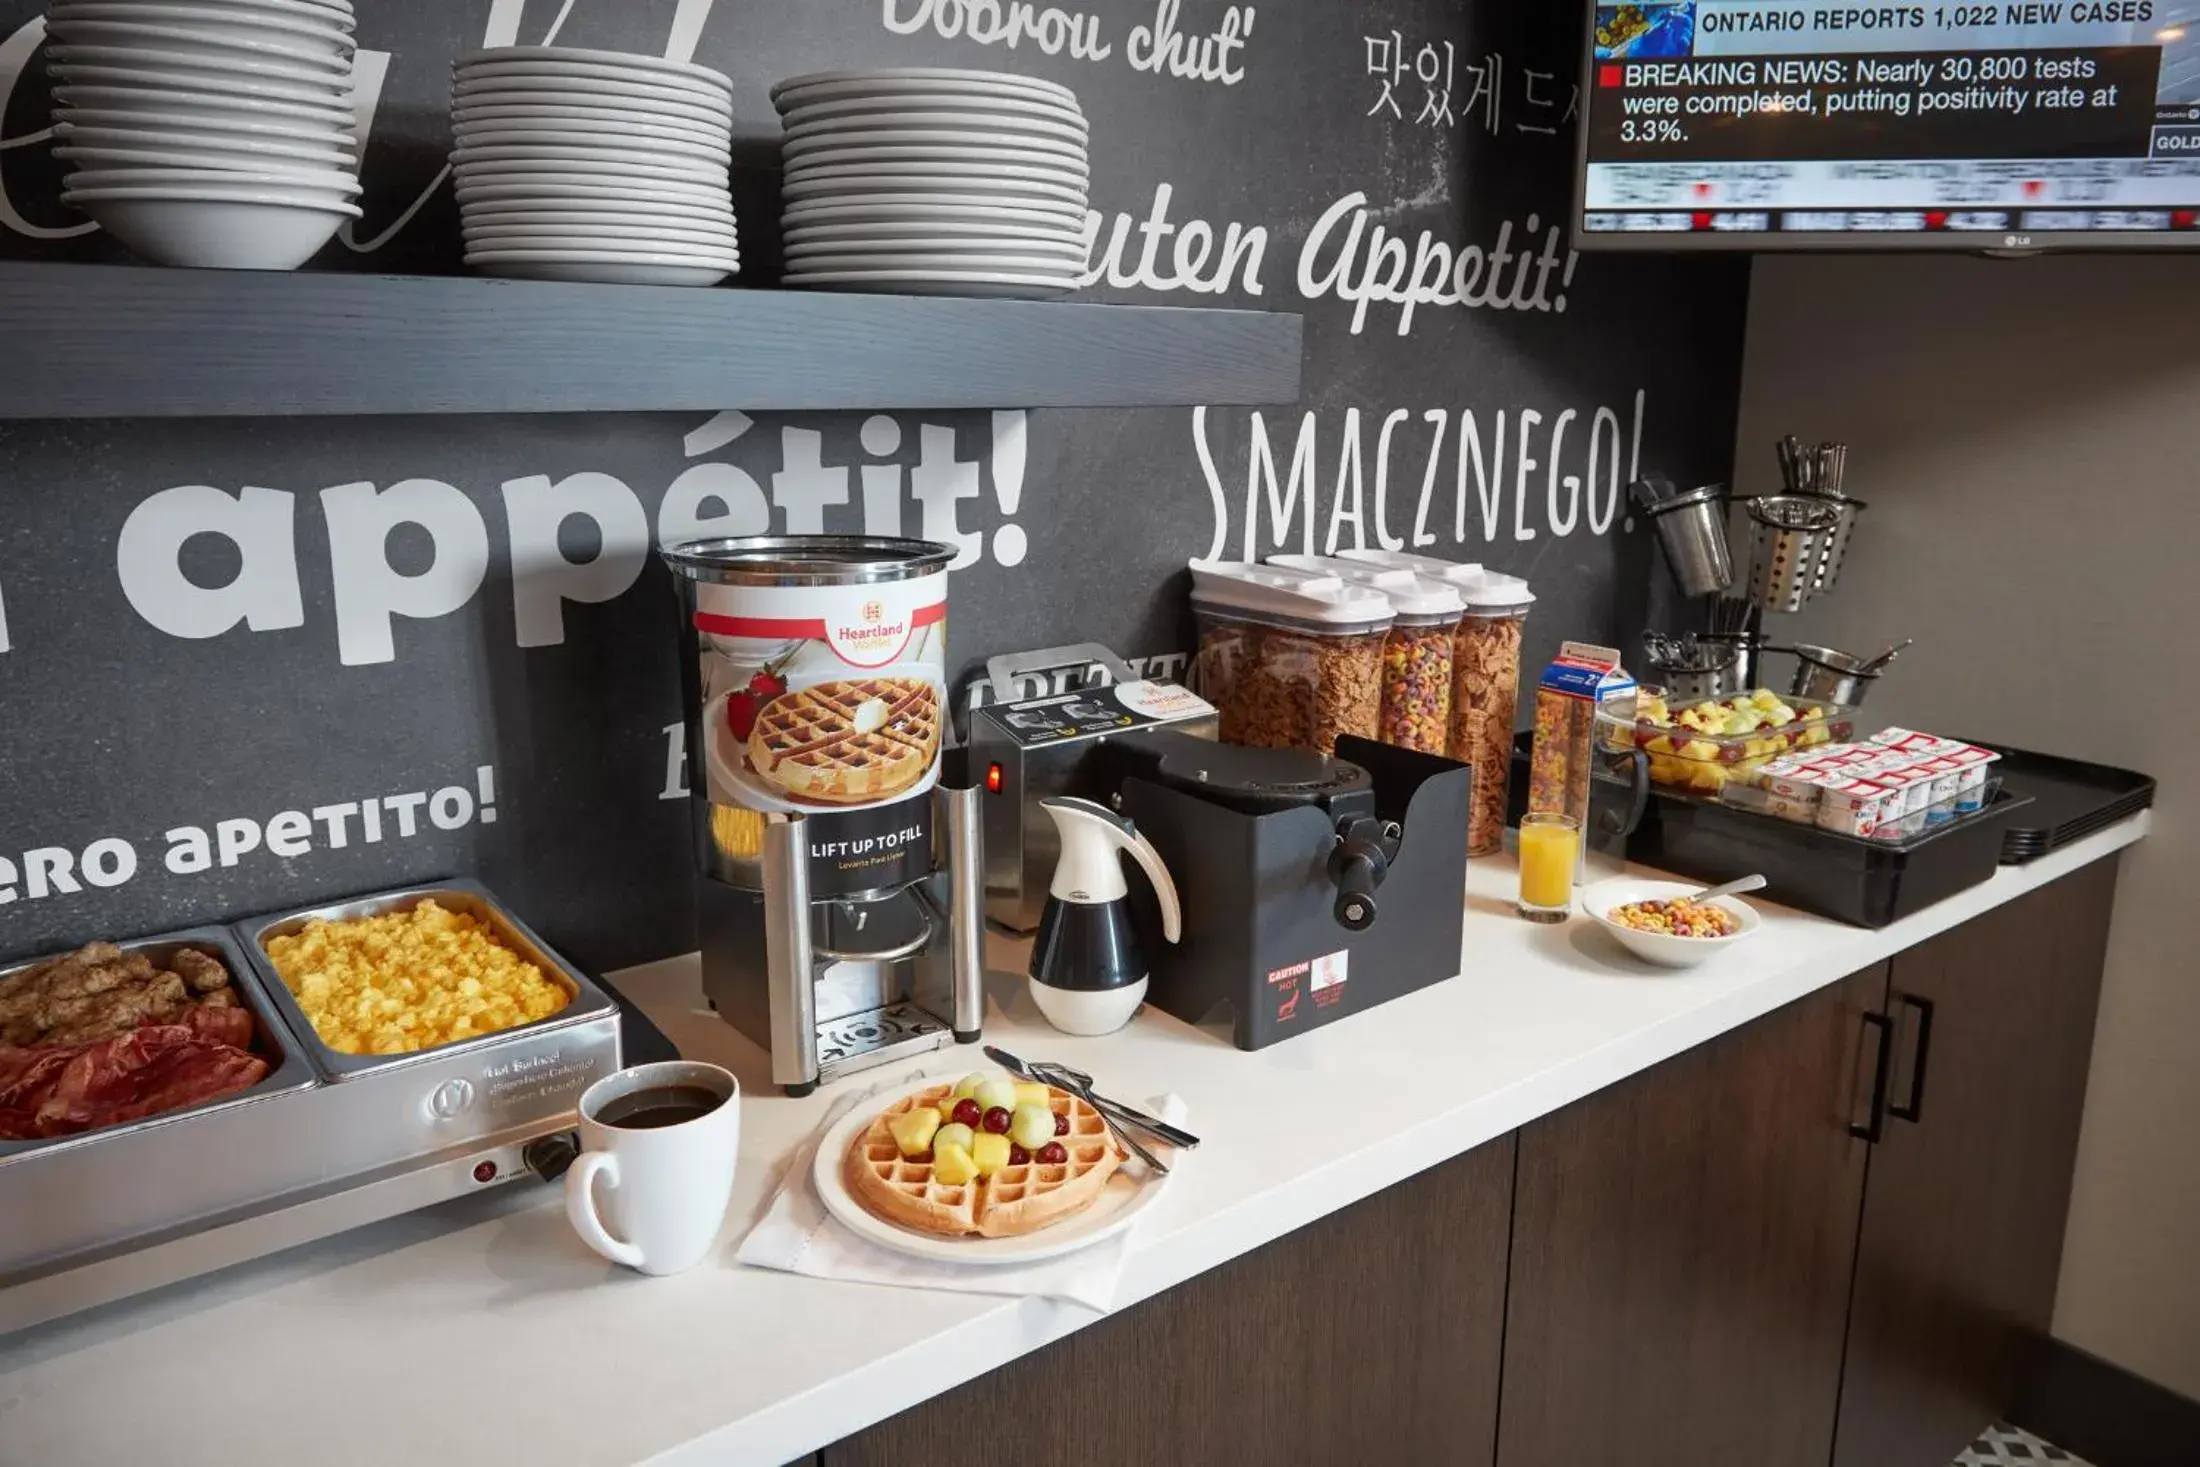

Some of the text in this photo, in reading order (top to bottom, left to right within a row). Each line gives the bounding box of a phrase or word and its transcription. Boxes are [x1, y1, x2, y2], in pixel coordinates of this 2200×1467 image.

[1702, 0, 2154, 33] ONTARIO REPORTS 1,022 NEW CASES
[1363, 29, 1503, 136] 맛있게
[1625, 55, 2097, 88] BREAKING NEWS: Nearly 30,800 tests
[1623, 84, 2119, 119] were completed, putting positivity rate at
[1620, 119, 1689, 142] 3.3%.
[2156, 135, 2200, 149] GOLD
[1080, 183, 1579, 336] uten Appetit!
[1192, 388, 1645, 563] SMACZNEGO!
[117, 409, 1028, 666] appétit!
[839, 621, 903, 641] Heartland
[812, 824, 923, 857] LIFT UP TO FILL
[1268, 960, 1310, 984] CAUTION
